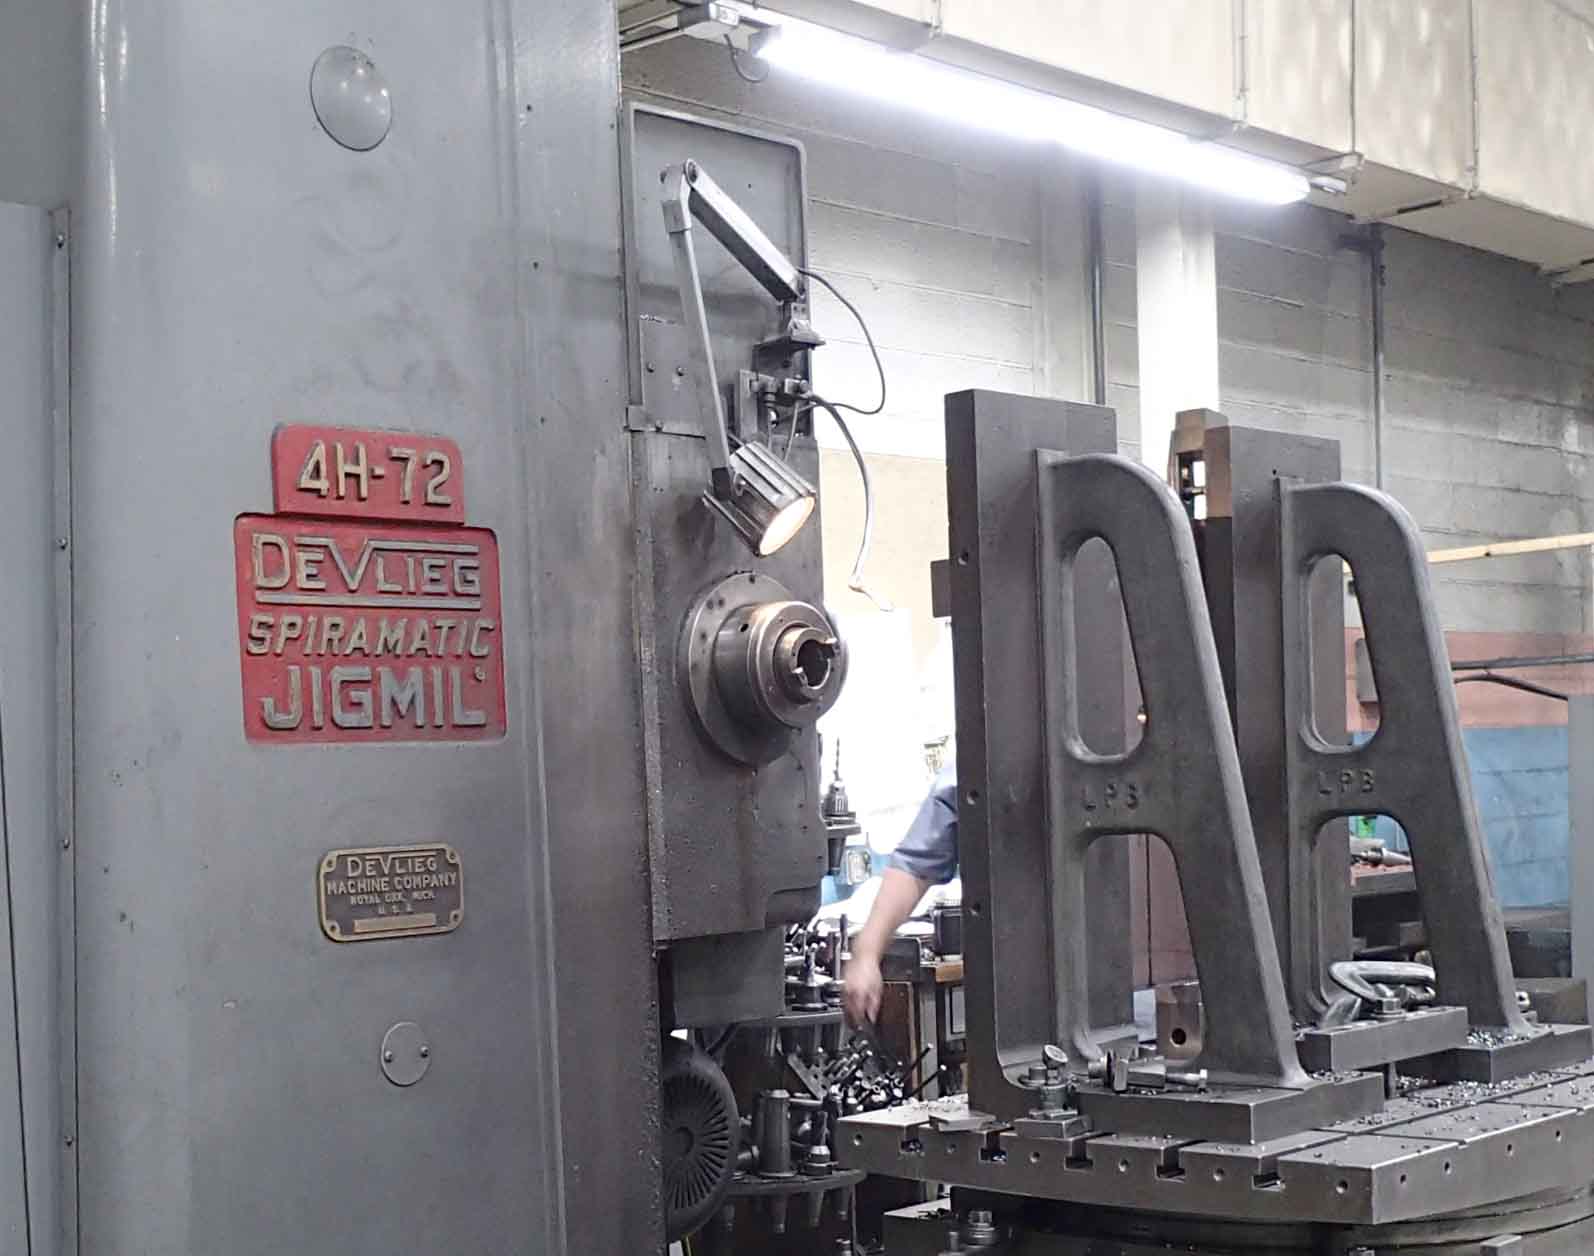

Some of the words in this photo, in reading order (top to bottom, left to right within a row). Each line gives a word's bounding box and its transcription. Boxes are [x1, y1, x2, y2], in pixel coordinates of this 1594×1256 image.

[296, 439, 451, 505] 4H-72
[246, 612, 495, 657] SPIRAMATIC
[327, 877, 390, 896] MACHINE
[393, 871, 457, 890] COMPANY
